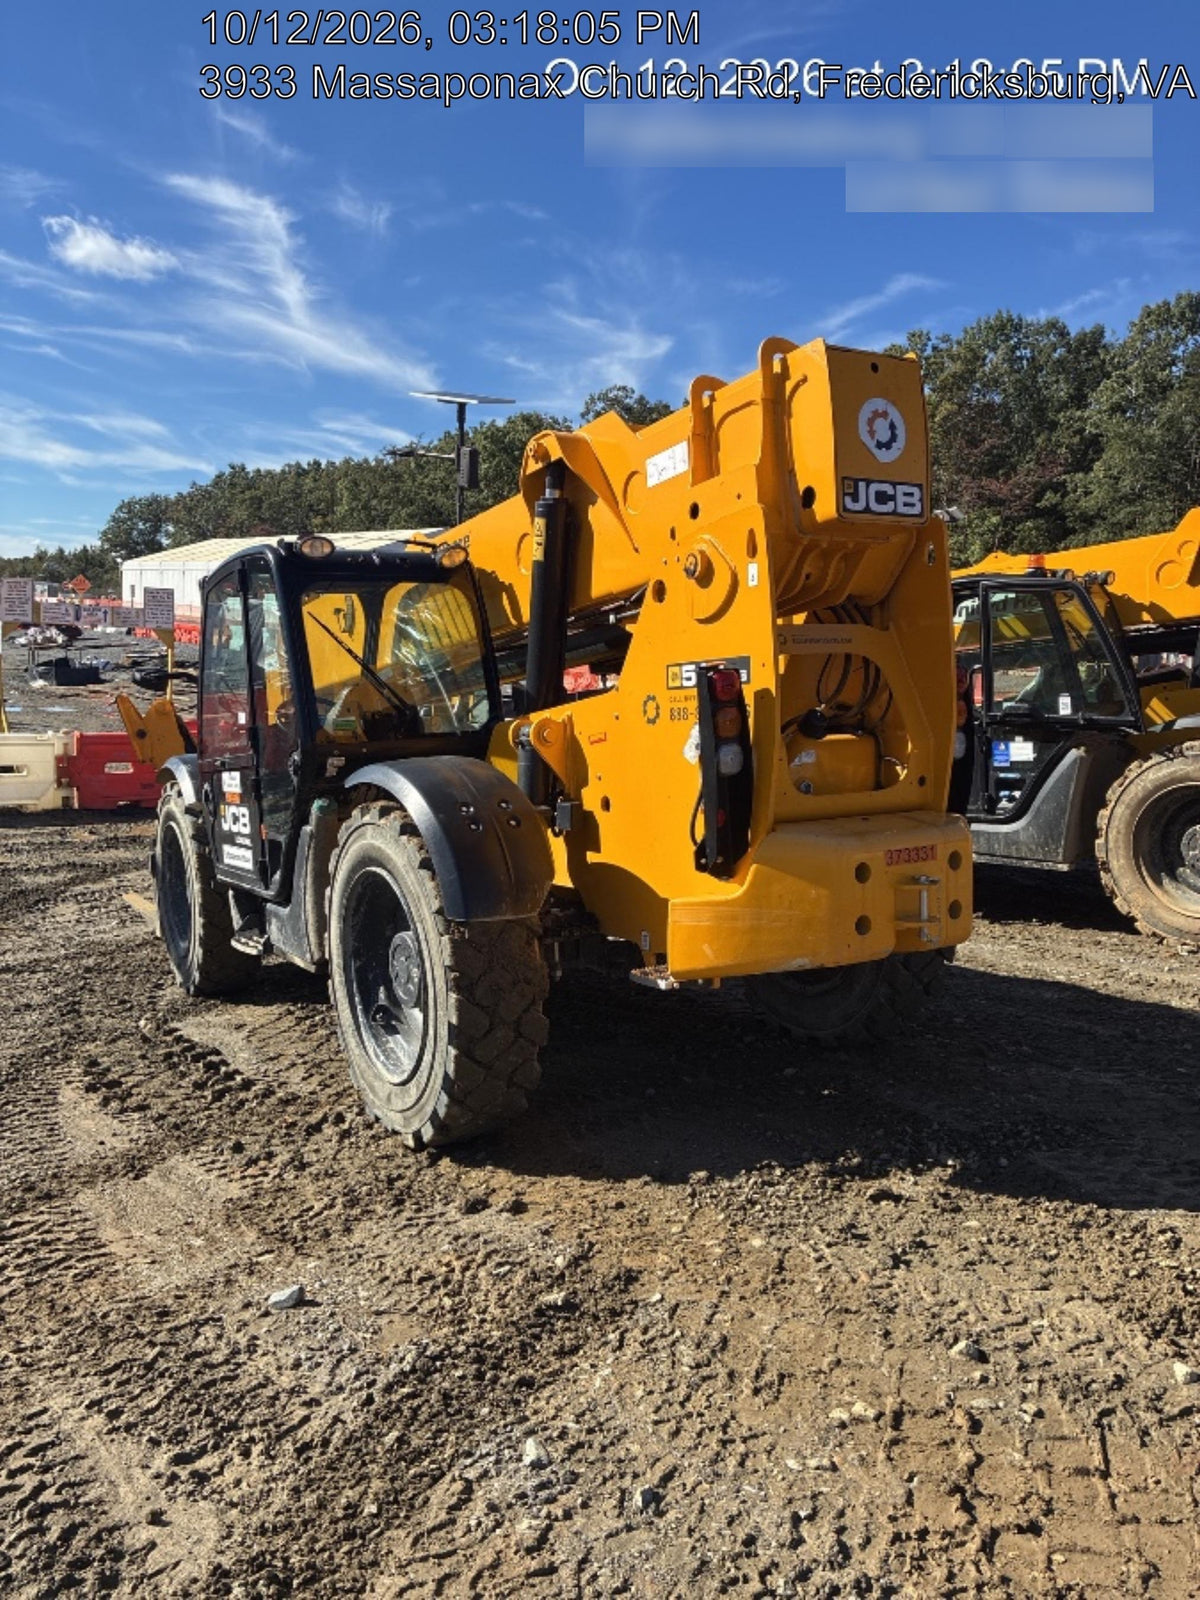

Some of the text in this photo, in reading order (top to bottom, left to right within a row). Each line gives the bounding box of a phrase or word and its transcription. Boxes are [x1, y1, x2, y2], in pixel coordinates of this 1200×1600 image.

[843, 481, 922, 515] JCB
[220, 805, 251, 835] JCB
[886, 845, 937, 866] 373331
